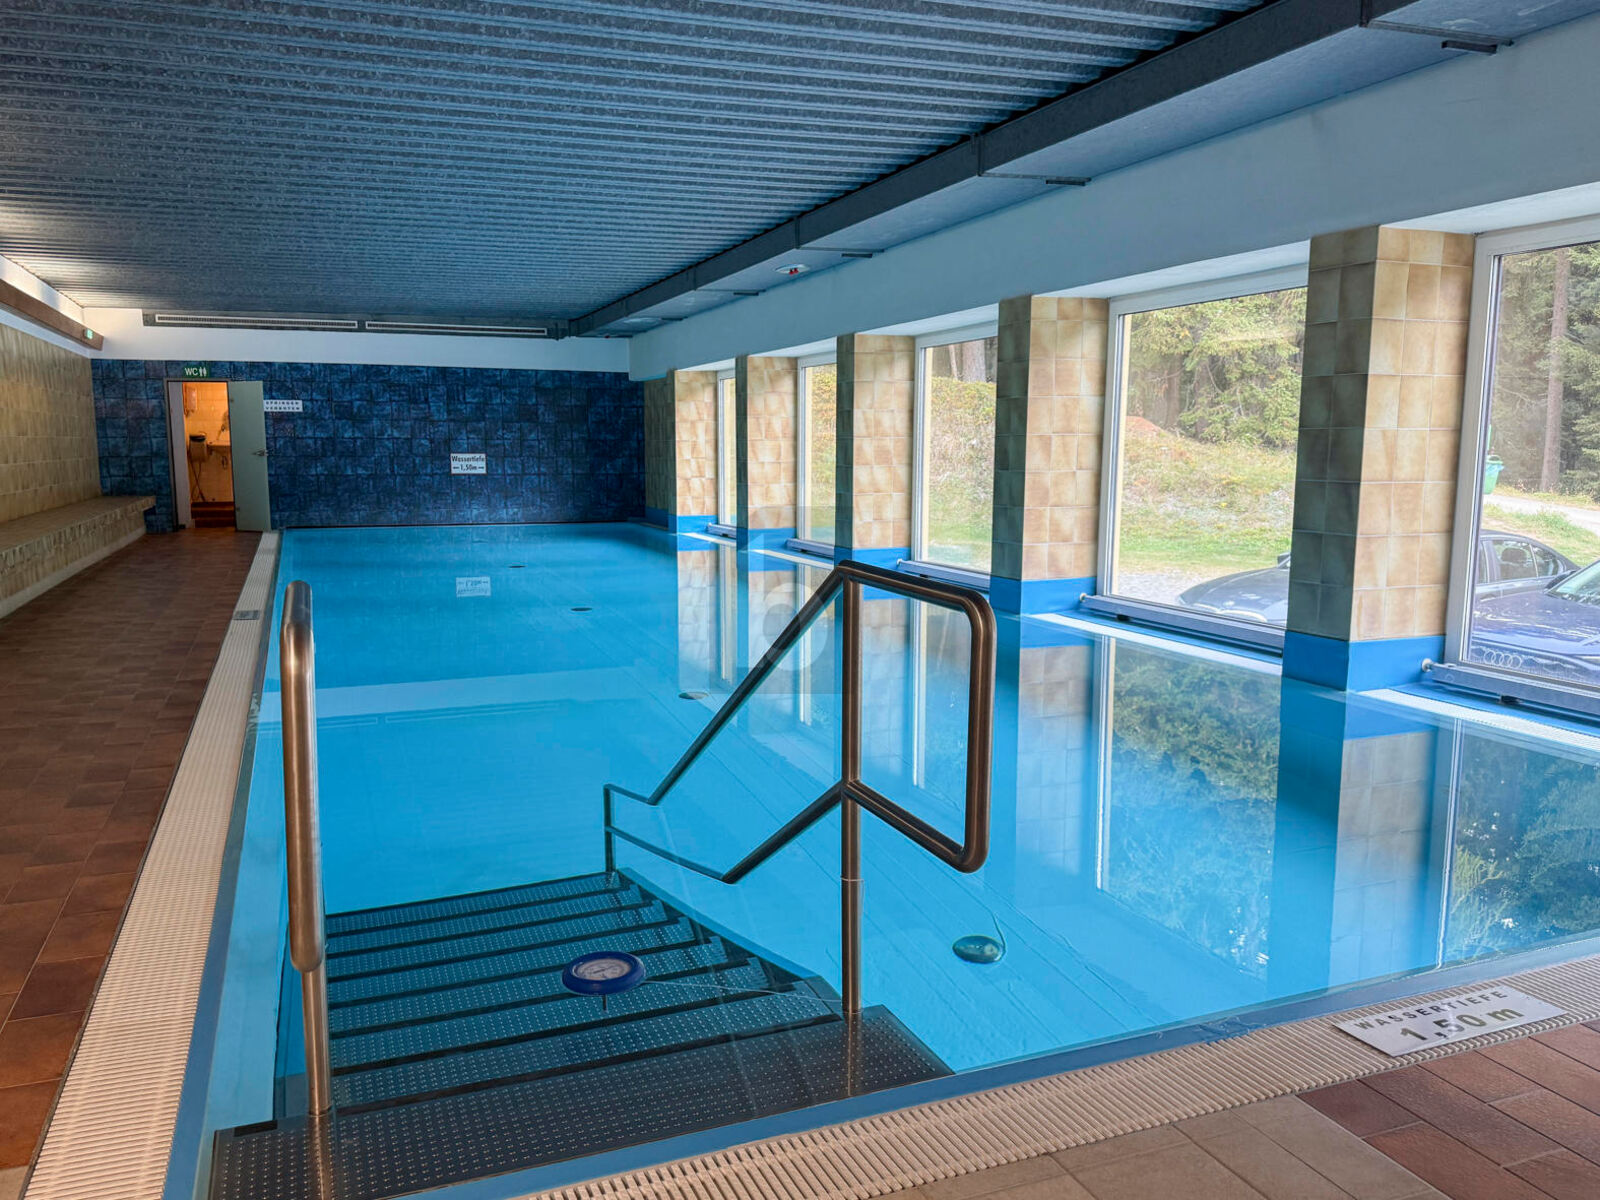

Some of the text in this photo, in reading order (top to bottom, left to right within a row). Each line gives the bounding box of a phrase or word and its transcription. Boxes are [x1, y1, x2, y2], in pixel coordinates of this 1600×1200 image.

[184, 367, 199, 376] WC
[451, 455, 485, 463] Wassertiefe
[1354, 990, 1508, 1030] WASSERTIEFE
